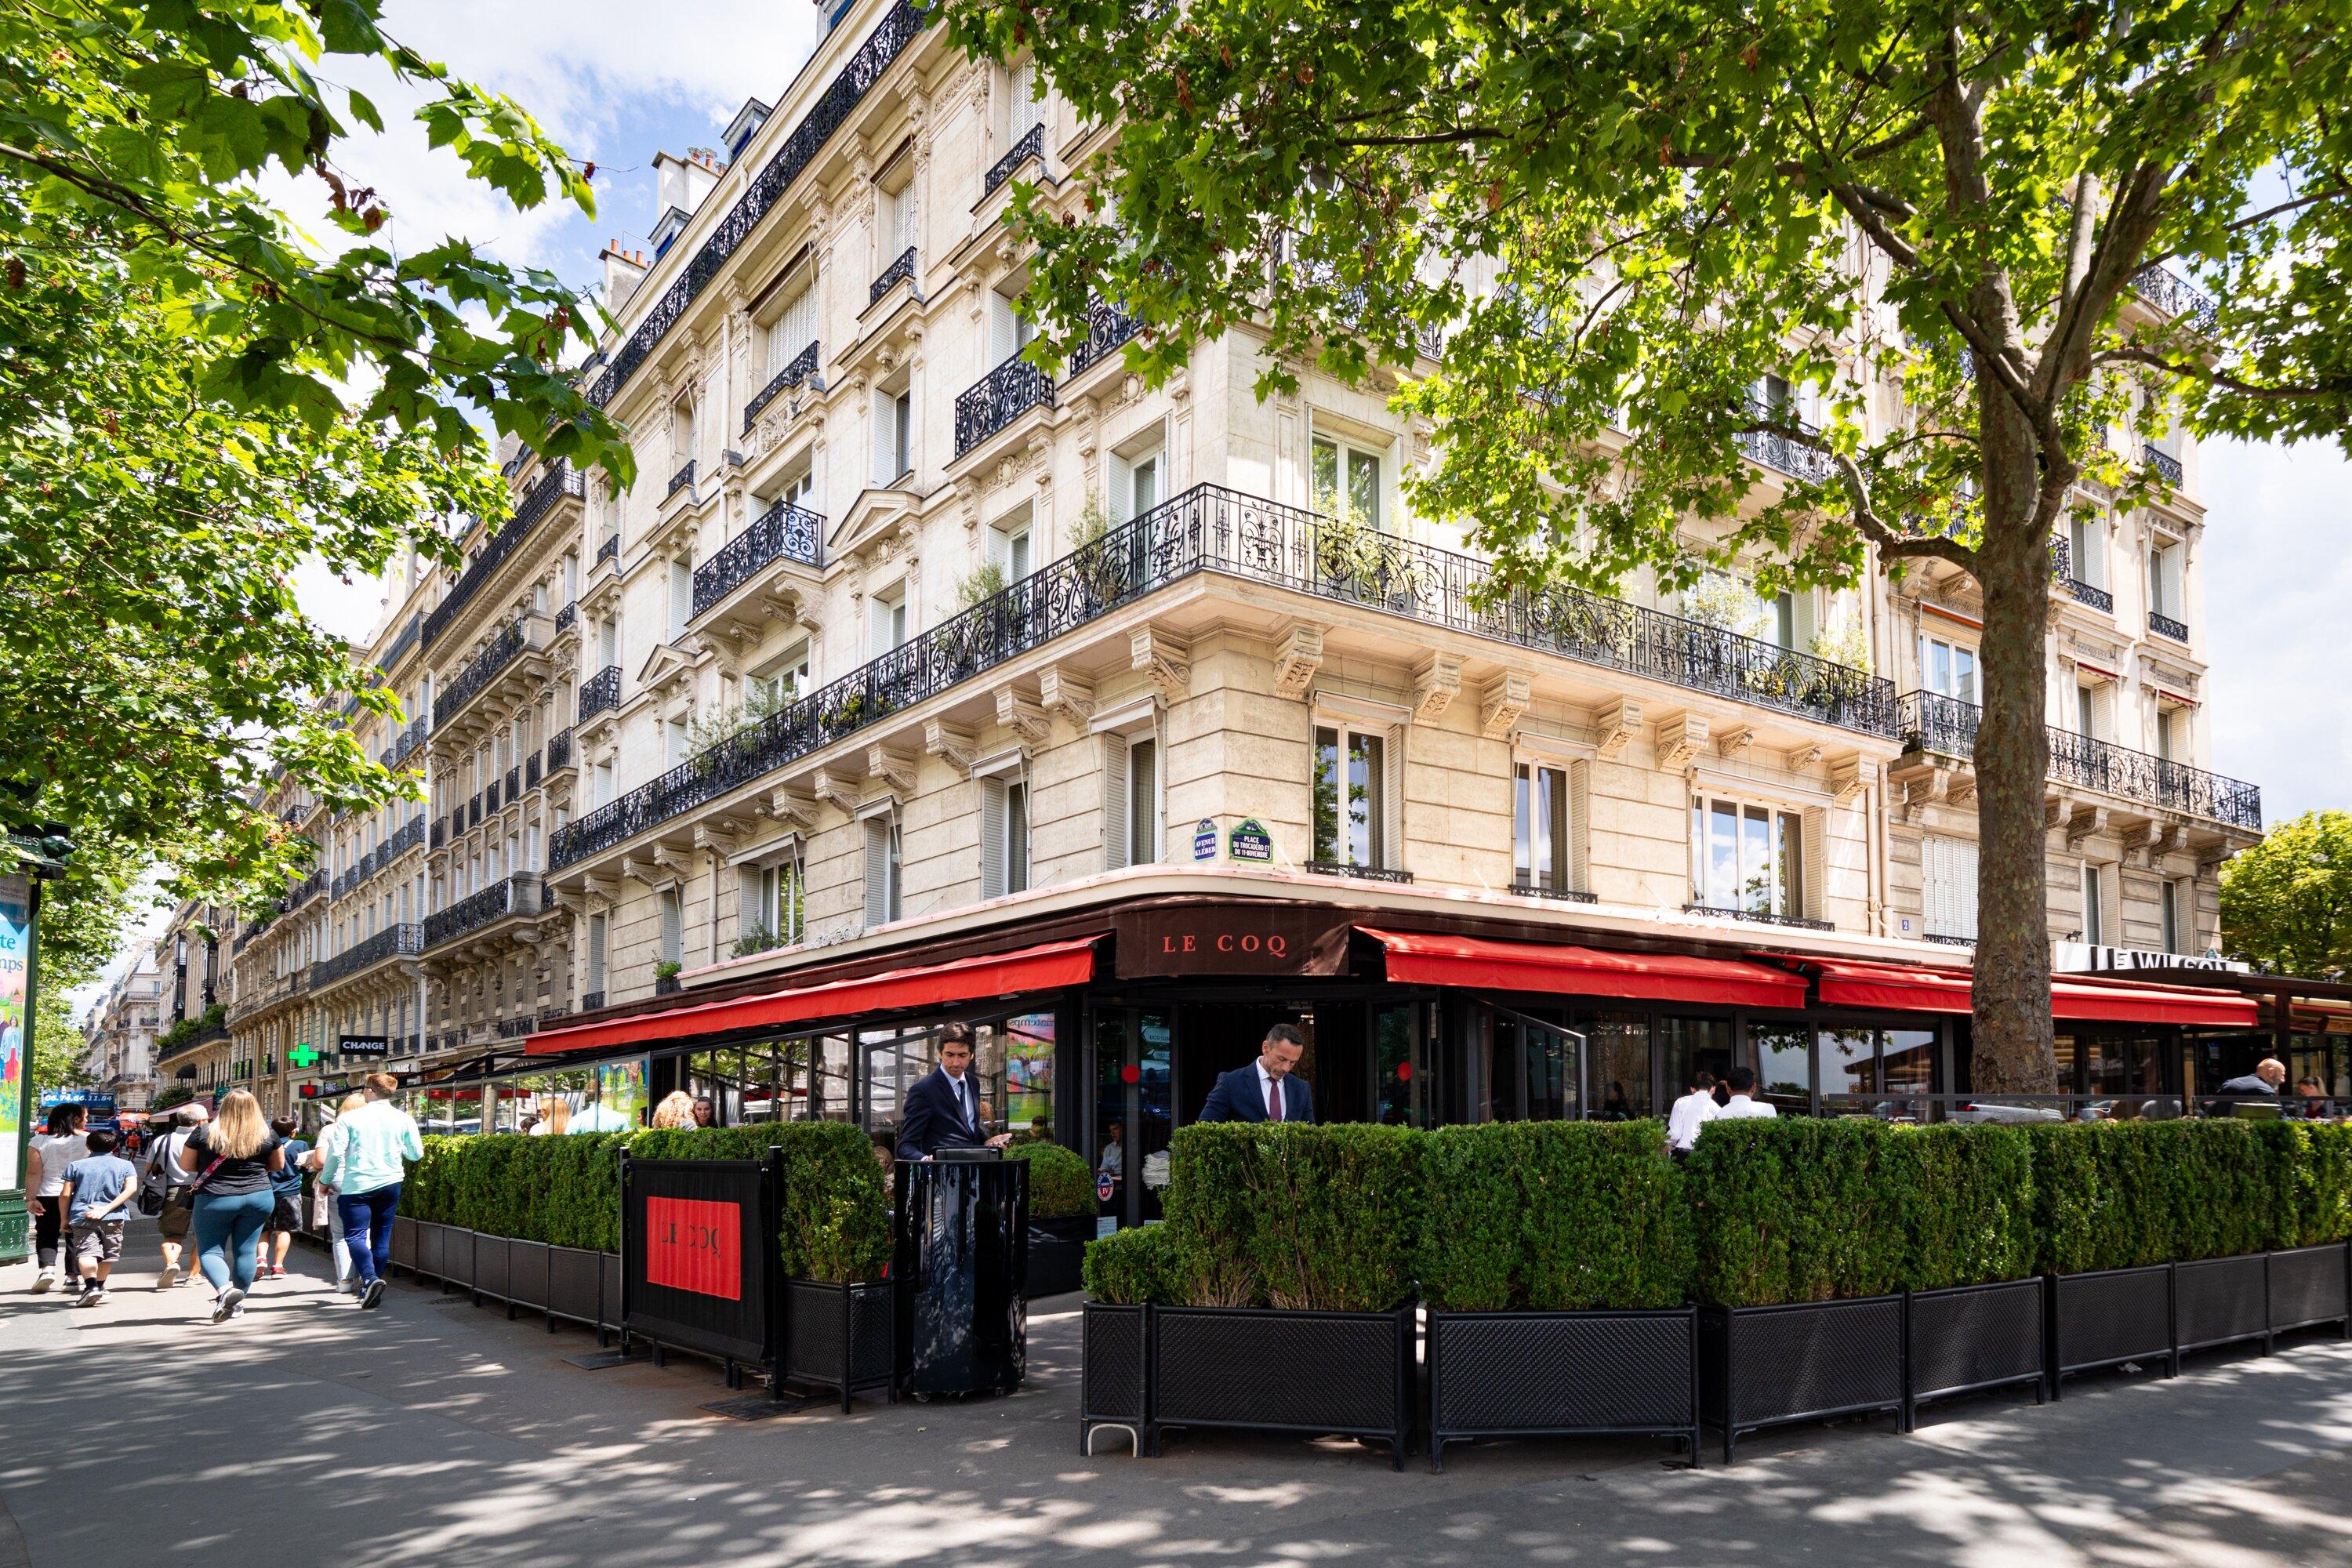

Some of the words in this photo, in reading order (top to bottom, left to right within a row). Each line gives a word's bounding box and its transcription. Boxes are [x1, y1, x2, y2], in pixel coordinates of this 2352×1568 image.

[1196, 837, 1215, 848] AVENUE
[1195, 846, 1215, 856] KLÉBER
[1903, 920, 1908, 930] 2
[1163, 935, 1196, 953] LE
[1217, 935, 1286, 958] COQ
[343, 1040, 385, 1050] CHANGE
